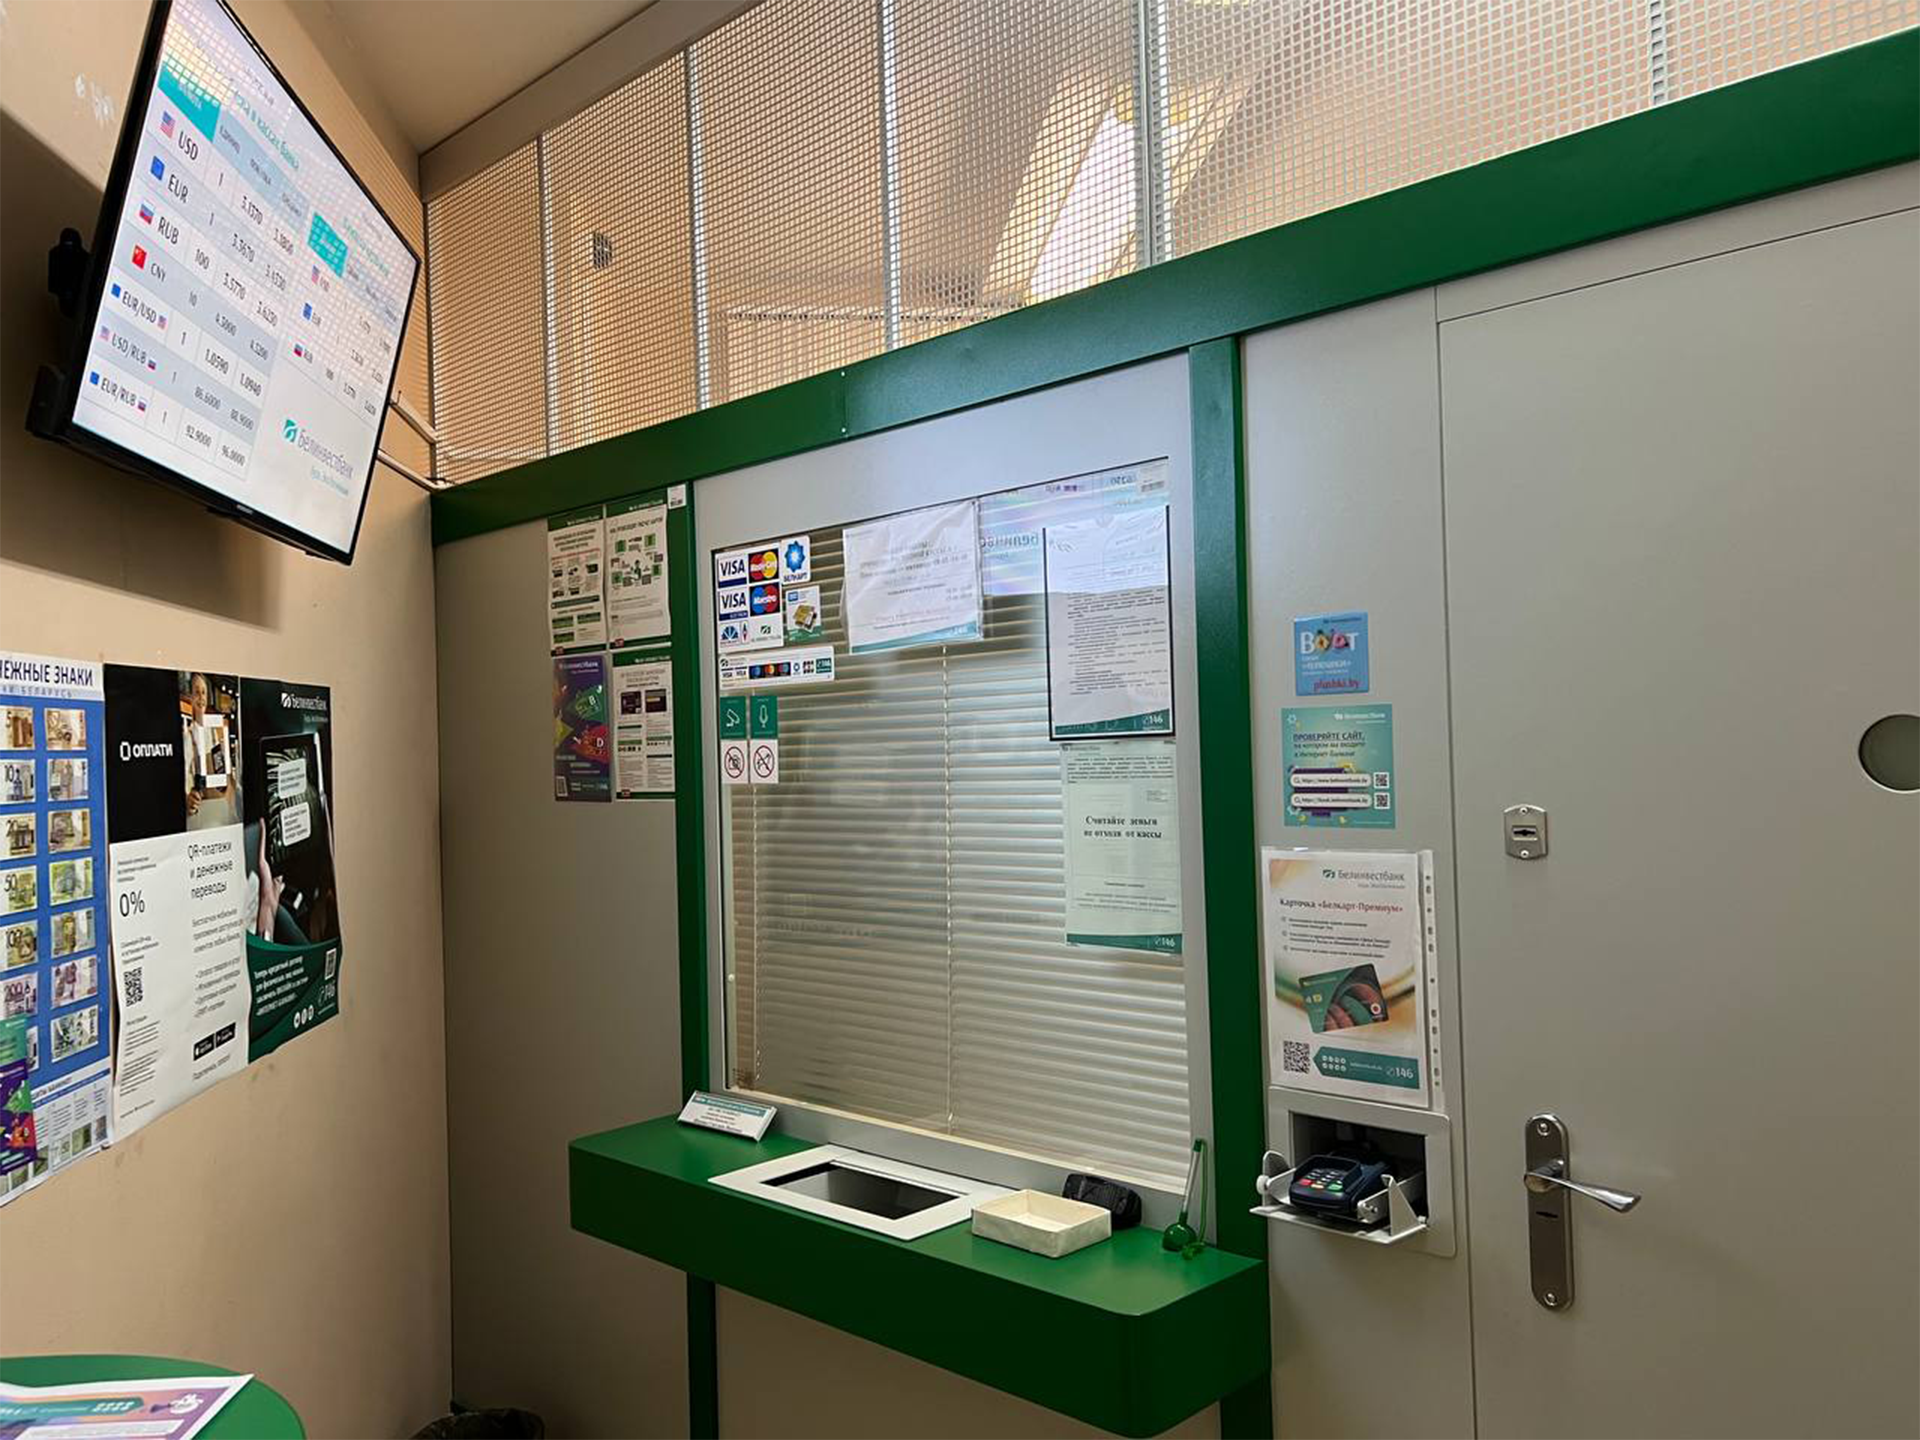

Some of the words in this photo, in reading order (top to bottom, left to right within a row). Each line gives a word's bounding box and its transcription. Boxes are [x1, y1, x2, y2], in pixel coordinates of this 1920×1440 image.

[178, 130, 199, 161] USD
[168, 173, 189, 204] EUR
[158, 216, 180, 245] RUB
[194, 248, 210, 270] 100
[150, 262, 167, 283] CNY
[121, 289, 158, 325] EUR/USD
[180, 332, 187, 346] 1
[111, 332, 148, 366] USD/RUB
[100, 377, 138, 406] EUR/RUB
[720, 558, 746, 577] VISA
[721, 592, 747, 610] VISA
[54, 665, 94, 686] ЗНАКИ
[1293, 731, 1339, 740] ПРОВЕРЯЙТЕ
[132, 743, 174, 758] ОПЛАТИ
[1085, 815, 1125, 826] Считайте
[1129, 817, 1158, 827] деньги
[1136, 831, 1162, 839] кассы
[188, 842, 232, 862] QR-платежи
[196, 860, 234, 878] денежные
[1338, 869, 1405, 880] Белинвестбанк
[191, 881, 227, 900] переводы
[120, 890, 145, 917] 0%
[1279, 899, 1316, 909] Карточка
[1318, 901, 1403, 914] «Белкарт-Премиум»
[1396, 1067, 1414, 1079] 146
